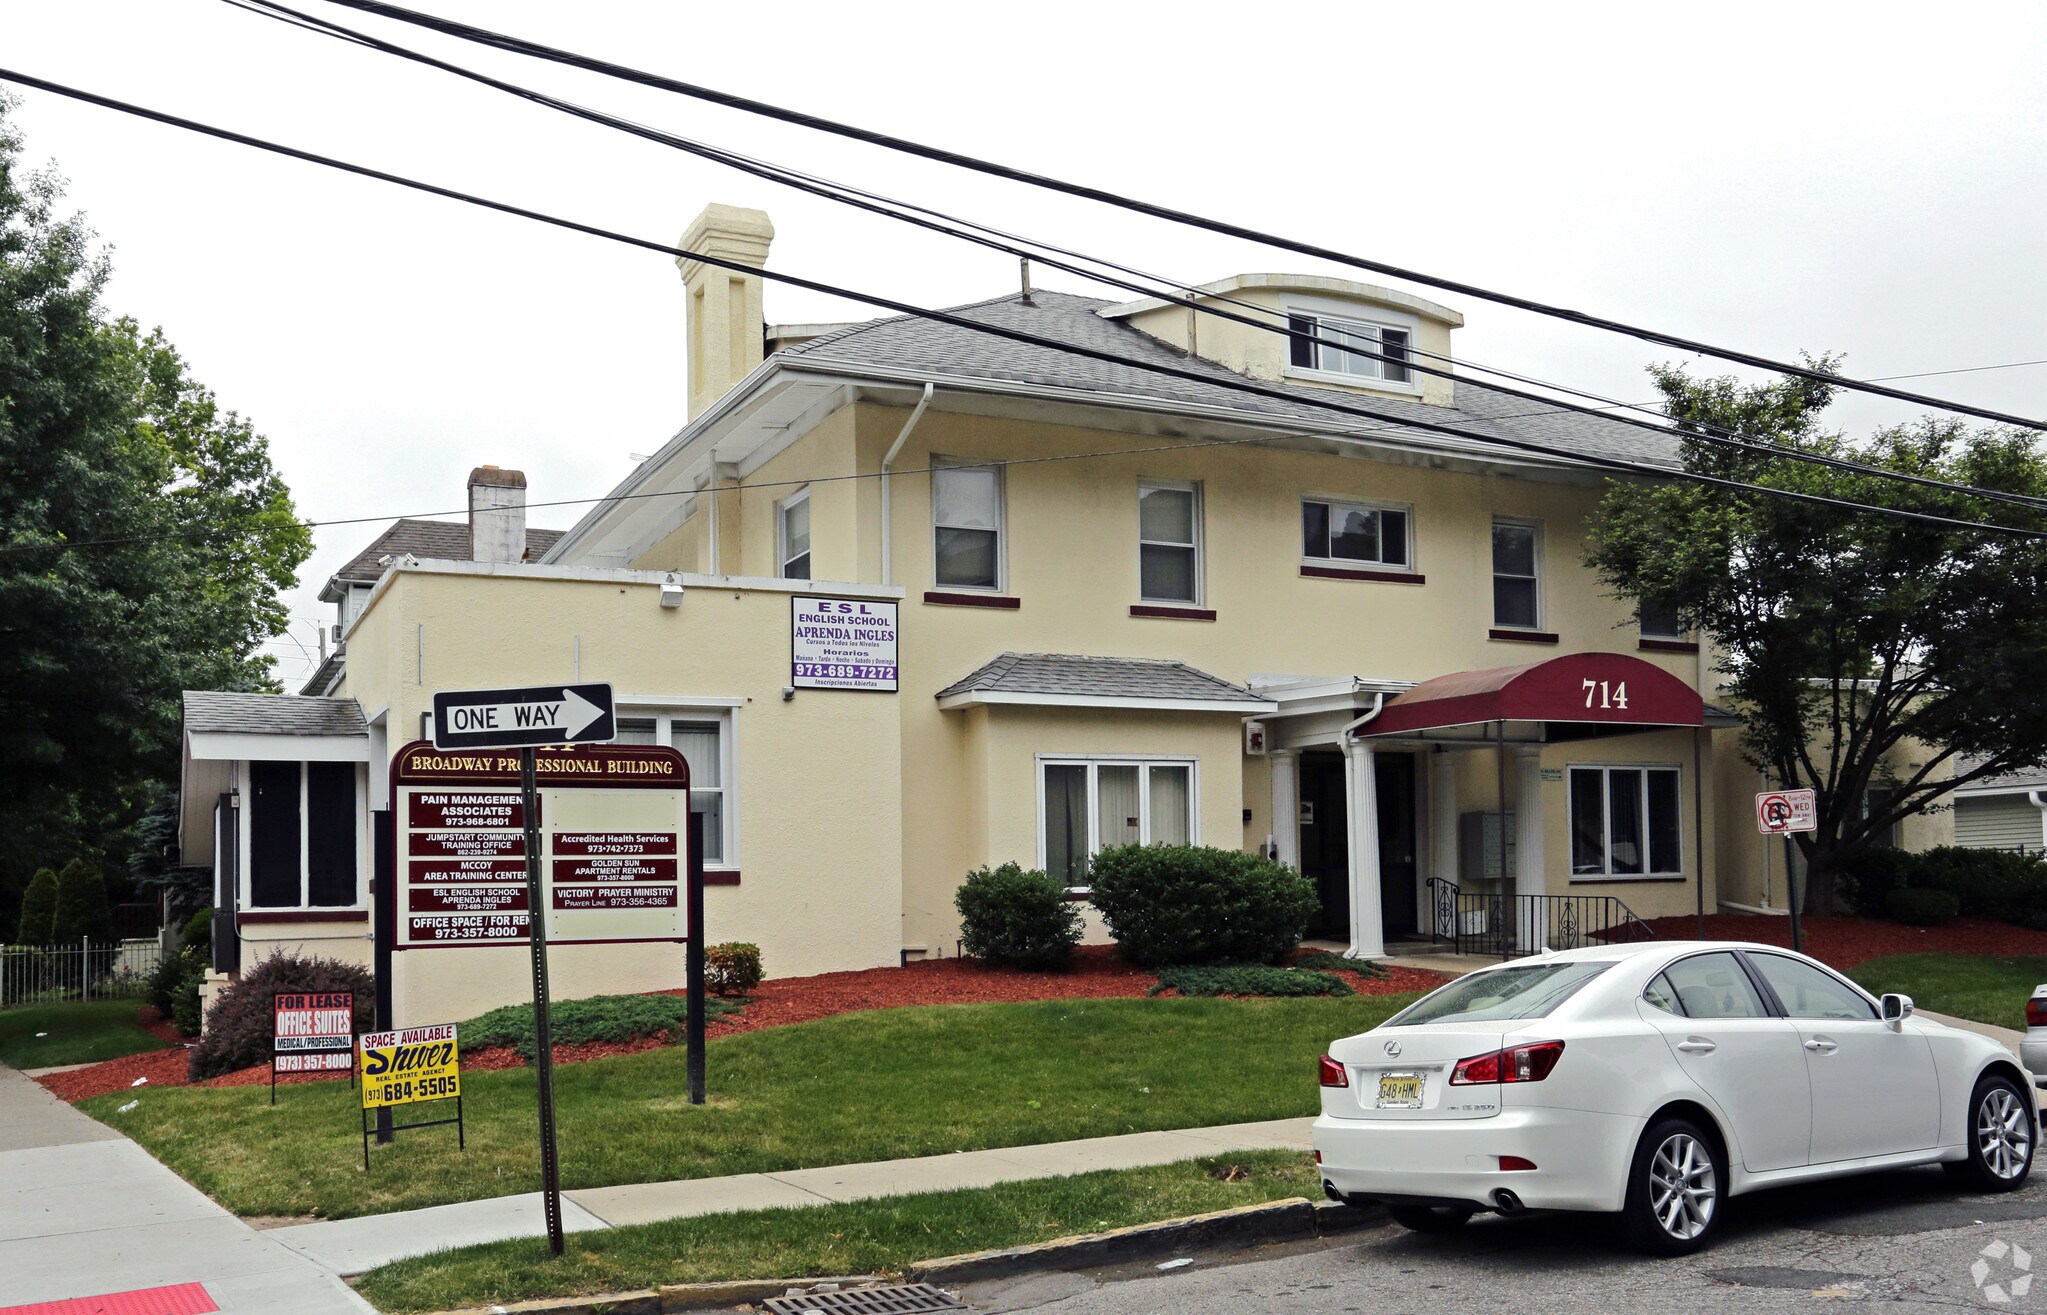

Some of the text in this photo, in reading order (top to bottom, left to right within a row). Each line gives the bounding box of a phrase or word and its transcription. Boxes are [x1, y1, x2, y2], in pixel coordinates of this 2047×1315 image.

[799, 614, 890, 626] ENGLISH SCHOOL
[795, 626, 895, 642] APRENDA INGLES
[796, 664, 894, 679] 973-689-7272
[1582, 678, 1628, 709] 714
[454, 704, 560, 730] ONE WAY
[412, 756, 673, 774] BROADWAY PRESSIONAL BUILDING
[421, 795, 523, 804] PAIN MANAGEMEN
[441, 807, 512, 815] ASSOCIATES
[1794, 802, 1809, 811] WED
[445, 818, 509, 826] 973-968-6801
[477, 833, 525, 841] COMMUNITY
[561, 835, 669, 843] Accredited Health Services
[441, 841, 512, 849] TRAINING OFFICE
[424, 872, 448, 880] AREA
[450, 872, 492, 880] TRAINING
[575, 867, 621, 875] APARTMENT
[557, 888, 674, 898] VICTORY PRAYER MINISTRY
[610, 897, 668, 906] 973-356-4365
[413, 918, 449, 928] OFFICE
[451, 917, 483, 927] SPACE
[491, 916, 510, 926] FOR
[513, 916, 530, 925] REN
[435, 927, 517, 938] 973-357-8000
[277, 995, 351, 1009] FOR LEASE
[277, 1010, 350, 1036] OFFICE SUITES
[277, 1036, 349, 1049] MEDICAL/PROFESSIONAL
[365, 1026, 452, 1049] SPACE AVAILABLE
[275, 1053, 352, 1071] (973) 357-8000
[366, 1043, 453, 1075] Shiver
[396, 1072, 418, 1080] ESTATE
[422, 1068, 445, 1076] AGENCY
[384, 1076, 456, 1101] 684-5505
